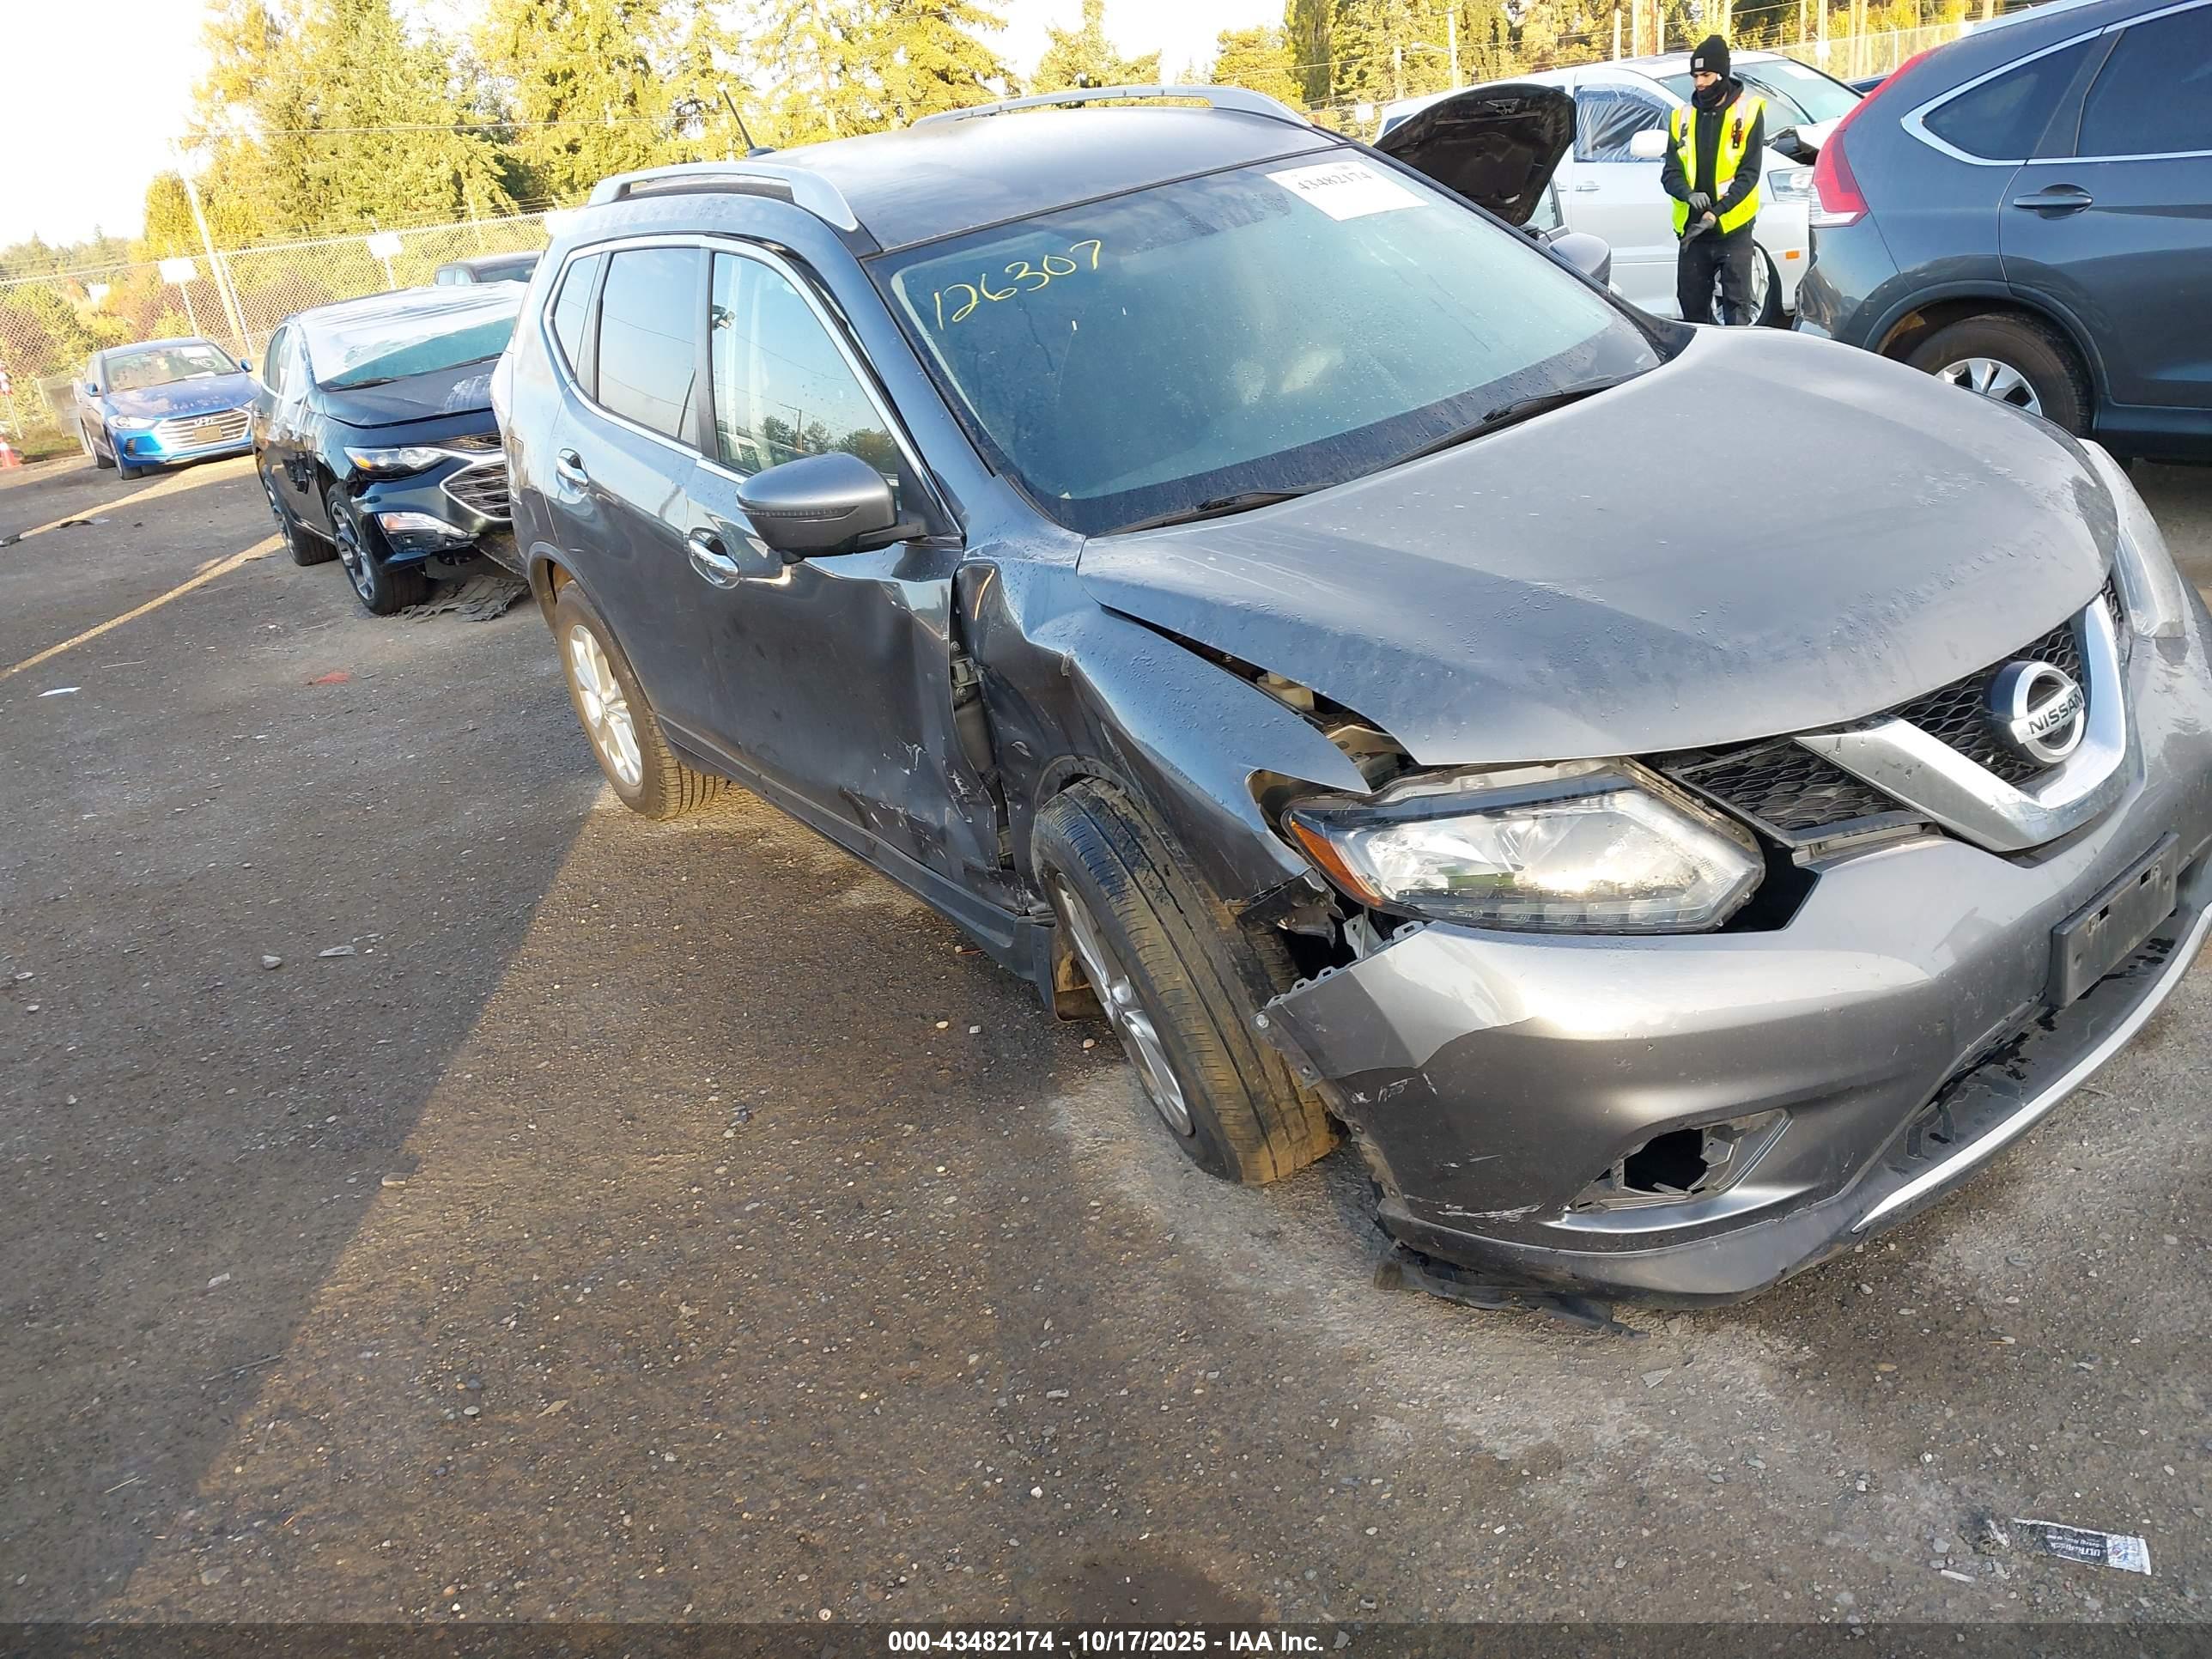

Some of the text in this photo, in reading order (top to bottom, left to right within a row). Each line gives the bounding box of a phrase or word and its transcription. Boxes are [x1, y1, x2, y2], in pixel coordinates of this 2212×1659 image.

[1297, 171, 1374, 191] 43482174
[933, 239, 1102, 331] 126307
[2027, 690, 2084, 735] NISSAN
